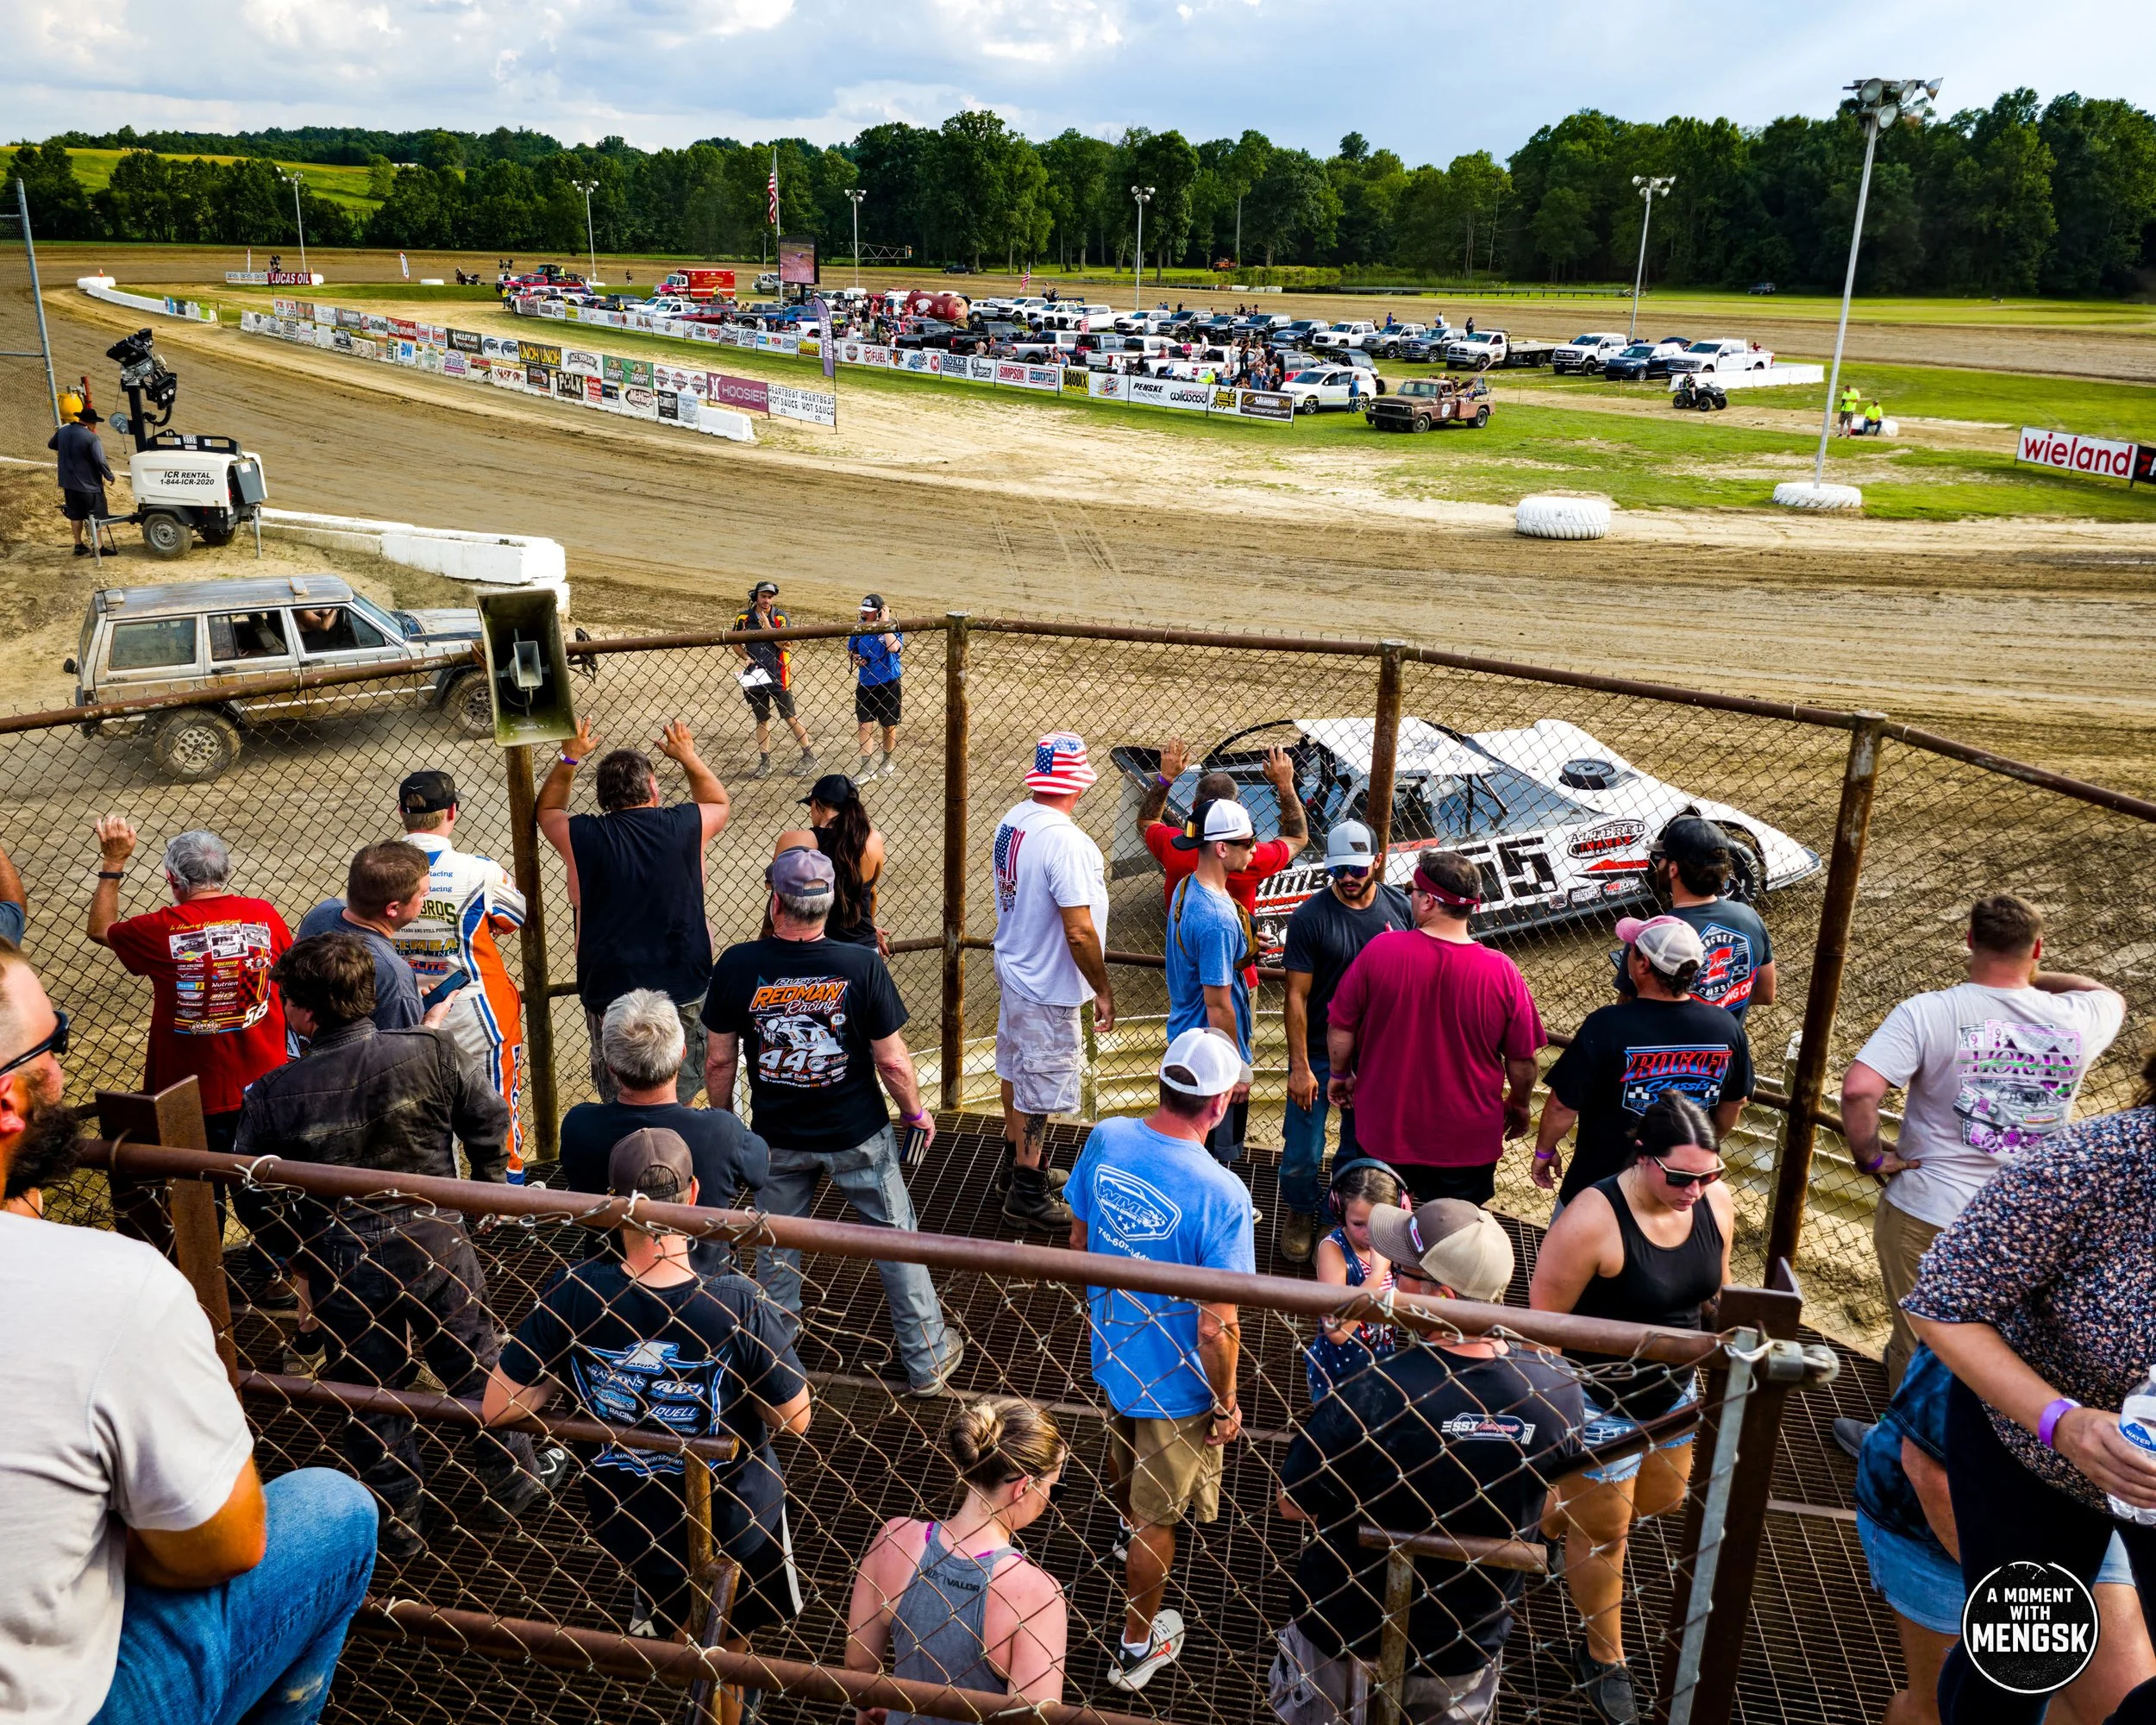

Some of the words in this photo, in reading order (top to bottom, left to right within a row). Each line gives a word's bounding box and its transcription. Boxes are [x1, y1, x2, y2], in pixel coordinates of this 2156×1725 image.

[271, 273, 296, 285] LUCAS
[297, 273, 310, 285] OIL
[519, 344, 539, 361] UNOH
[540, 348, 561, 365] UNOH
[872, 352, 886, 363] FUEL
[889, 348, 904, 364] FOX
[943, 354, 967, 367] HOKER
[999, 366, 1025, 381] SIMPSON
[1063, 370, 1087, 388] BRODIX
[558, 373, 582, 394] POLK
[1133, 382, 1164, 393] PENSKE
[722, 384, 768, 404] HOOSIER
[768, 385, 799, 400] HEARTBEAT
[801, 392, 835, 405] HEARTBEAT
[1169, 390, 1207, 405] wilwood
[768, 396, 780, 407] HOT
[780, 398, 799, 410] SAUCE
[802, 403, 814, 413] HOT
[815, 405, 835, 416] SAUCE
[1254, 396, 1280, 407] Strange
[2024, 433, 2134, 476] wieland
[1570, 824, 1645, 843] ALTERED
[1580, 836, 1632, 851] IMAGES
[749, 982, 849, 1013] REDMAN
[242, 999, 269, 1029] 58
[786, 998, 843, 1016] Racing
[759, 1048, 811, 1072] 44
[1620, 1050, 1733, 1082] ROCKET
[1645, 1080, 1711, 1093] Chassis
[609, 1407, 636, 1423] RACING
[1452, 1421, 1479, 1432] SSI
[2125, 1427, 2151, 1446] WATER
